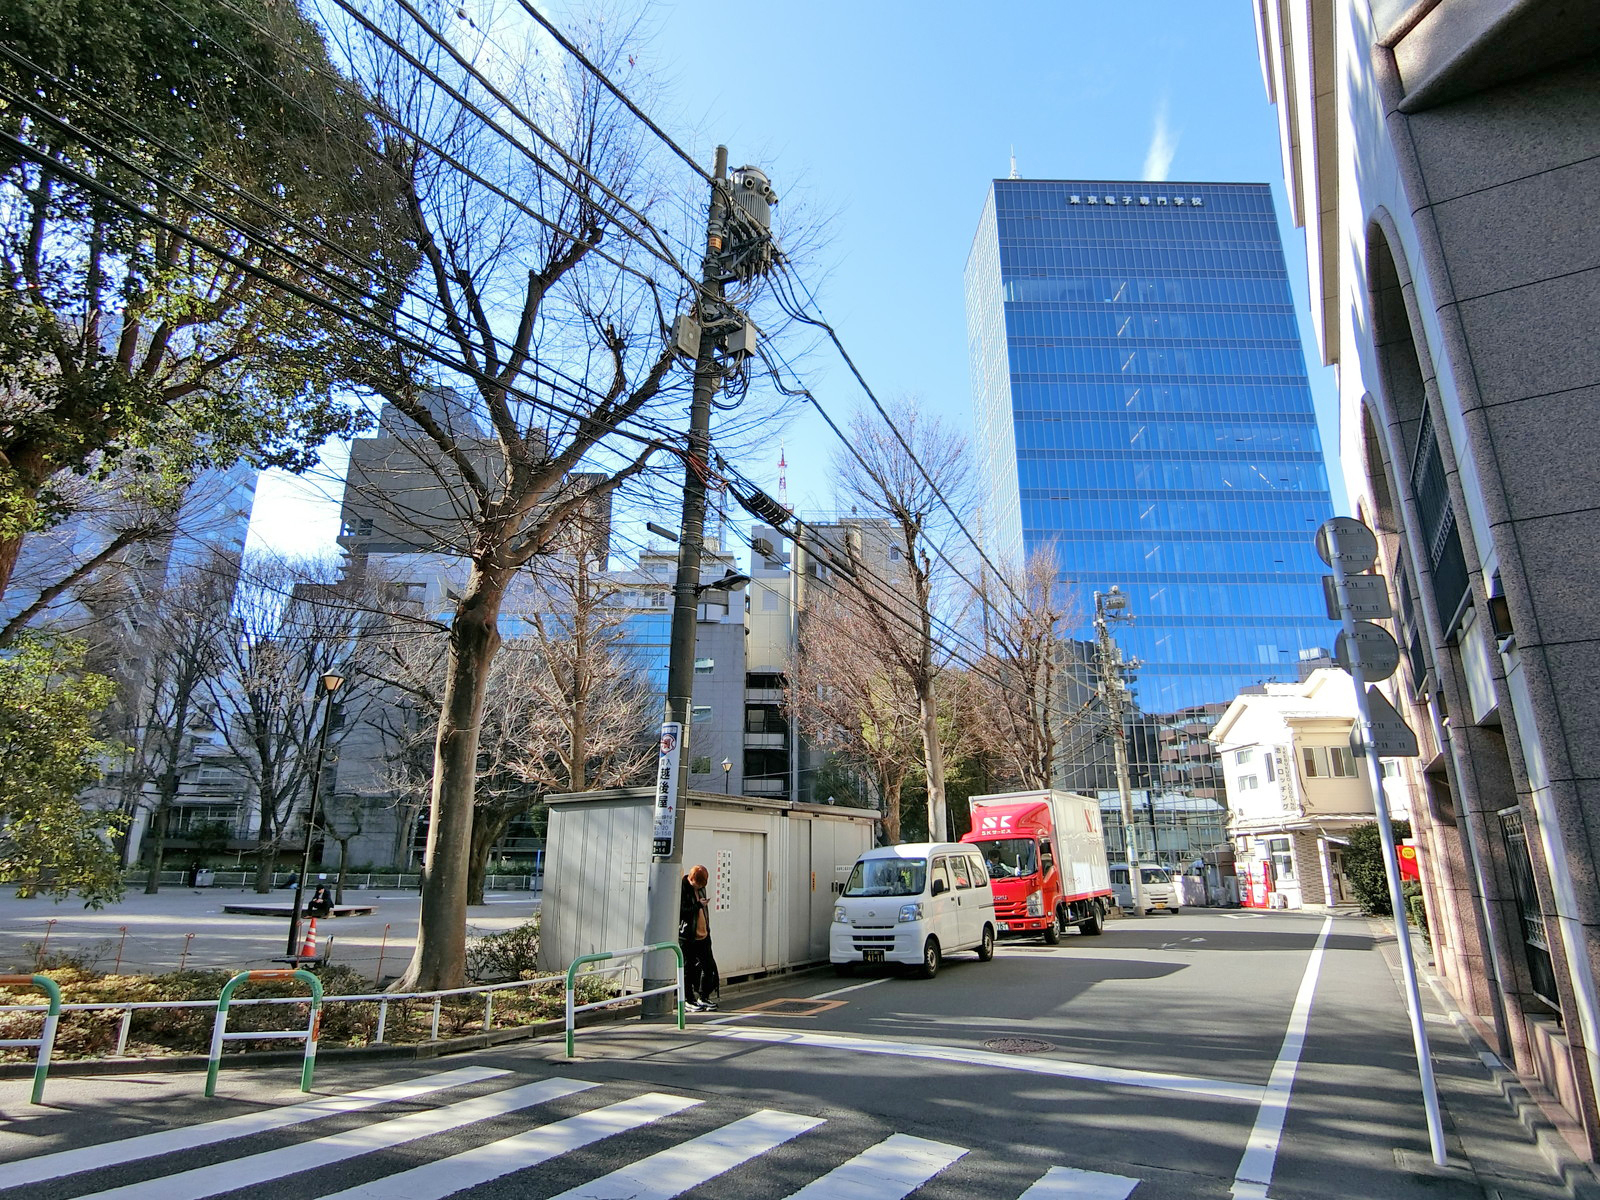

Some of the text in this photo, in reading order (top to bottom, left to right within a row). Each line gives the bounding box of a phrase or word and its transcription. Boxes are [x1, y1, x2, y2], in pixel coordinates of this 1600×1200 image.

[1069, 195, 1204, 207] 東京電子専門学校
[658, 767, 671, 808] 越後屋
[982, 815, 1013, 829] SK
